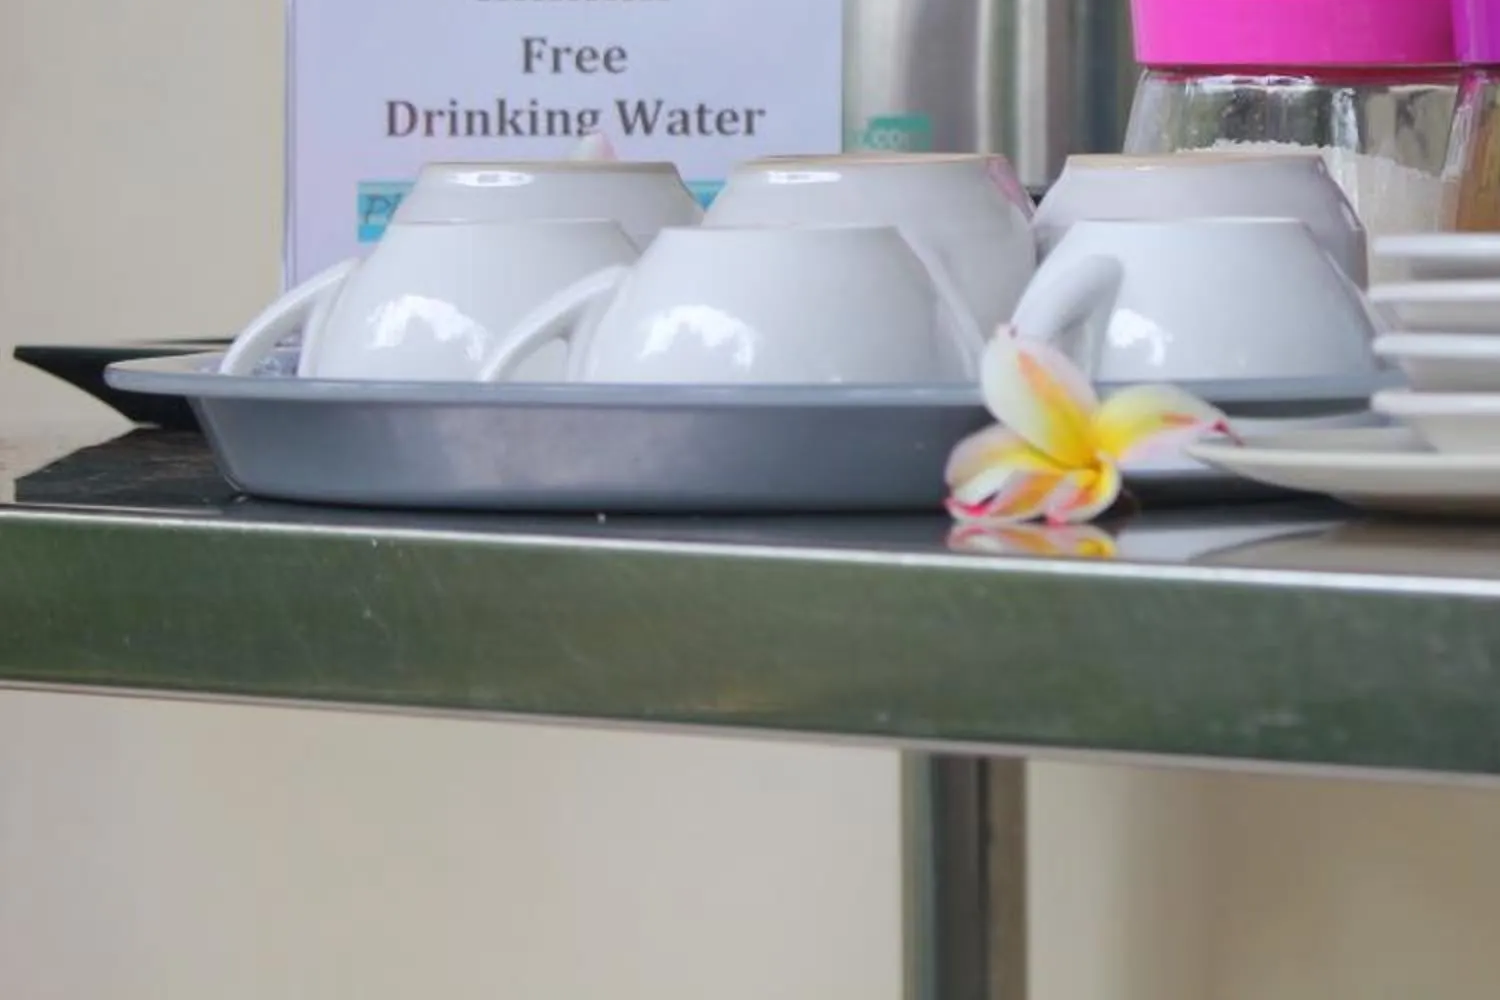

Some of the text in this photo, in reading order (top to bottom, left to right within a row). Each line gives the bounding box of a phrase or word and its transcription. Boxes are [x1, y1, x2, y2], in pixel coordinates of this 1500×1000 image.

[521, 36, 629, 74] Free
[386, 98, 767, 138] Drinking Water
